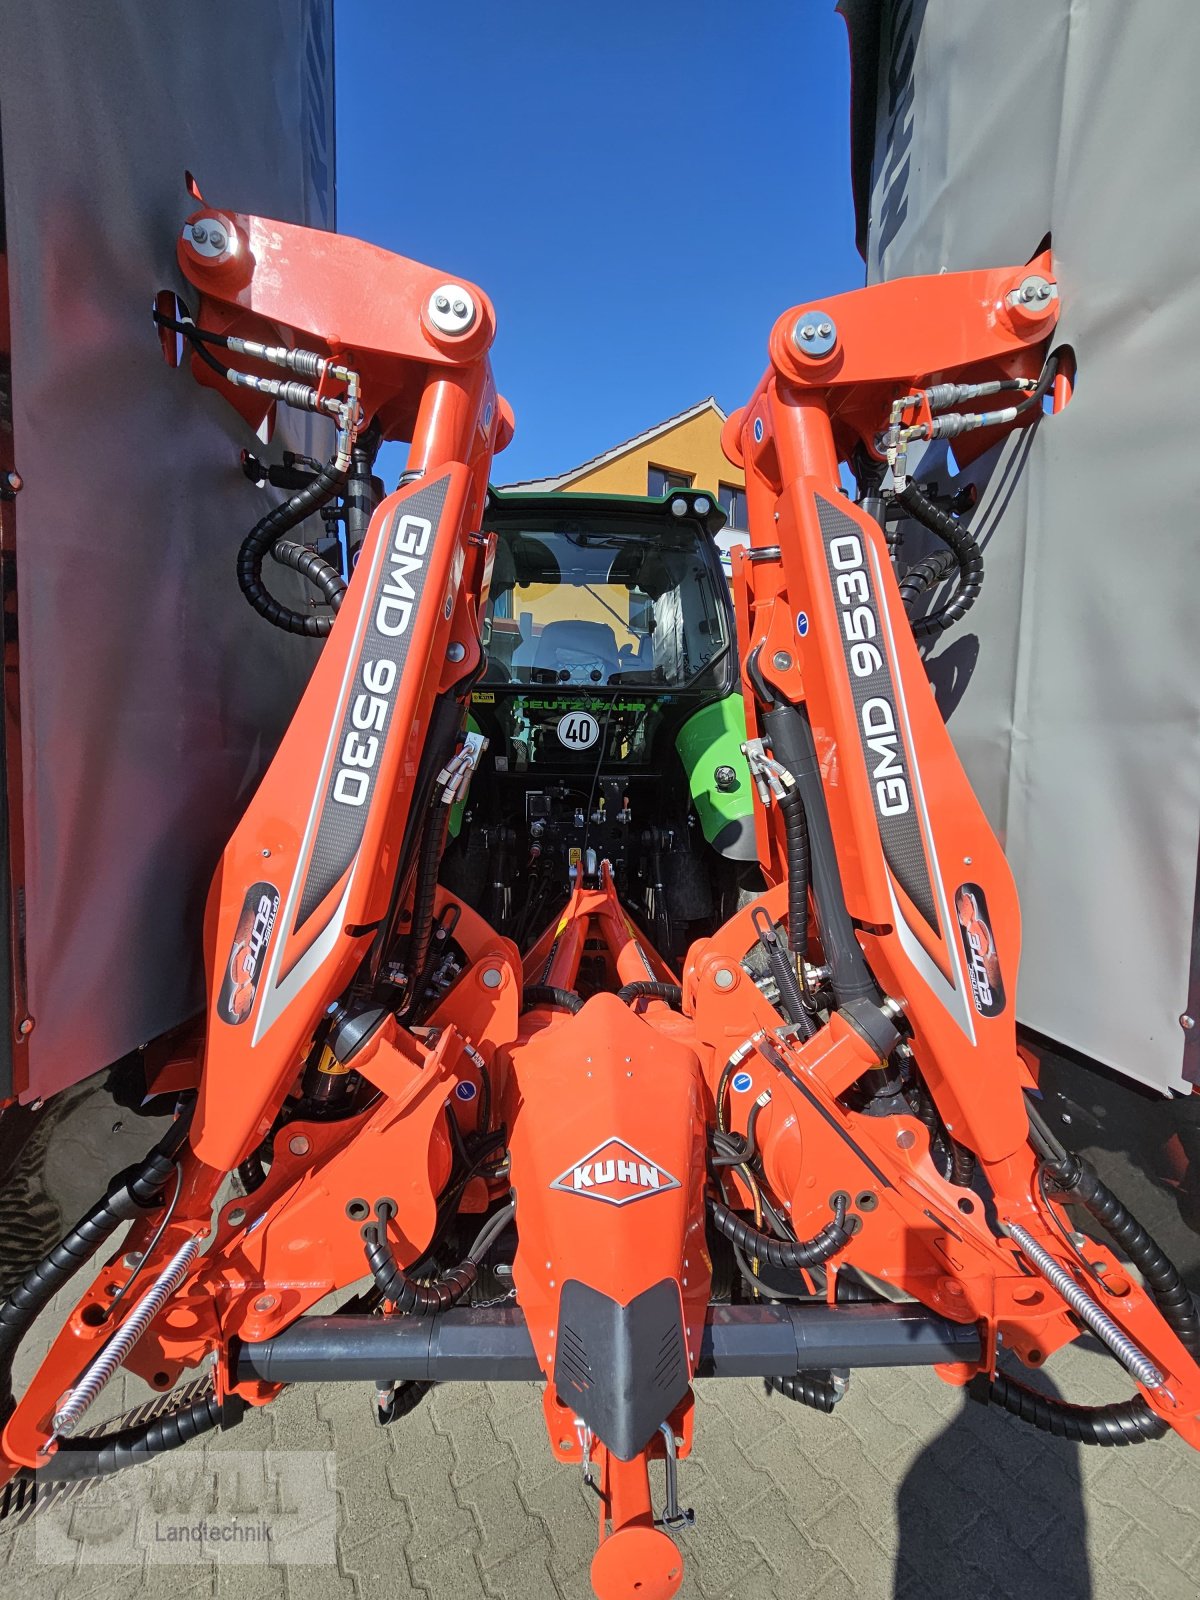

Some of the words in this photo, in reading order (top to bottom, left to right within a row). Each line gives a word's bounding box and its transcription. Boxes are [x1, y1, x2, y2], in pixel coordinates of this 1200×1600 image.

[375, 513, 432, 637] GMD
[830, 535, 883, 678] 9530
[333, 659, 397, 807] 9530
[565, 719, 591, 742] 40
[861, 696, 910, 817] GMD
[242, 894, 272, 980] ELITE
[968, 930, 993, 1006] ELITE
[573, 1159, 660, 1190] KUHN
